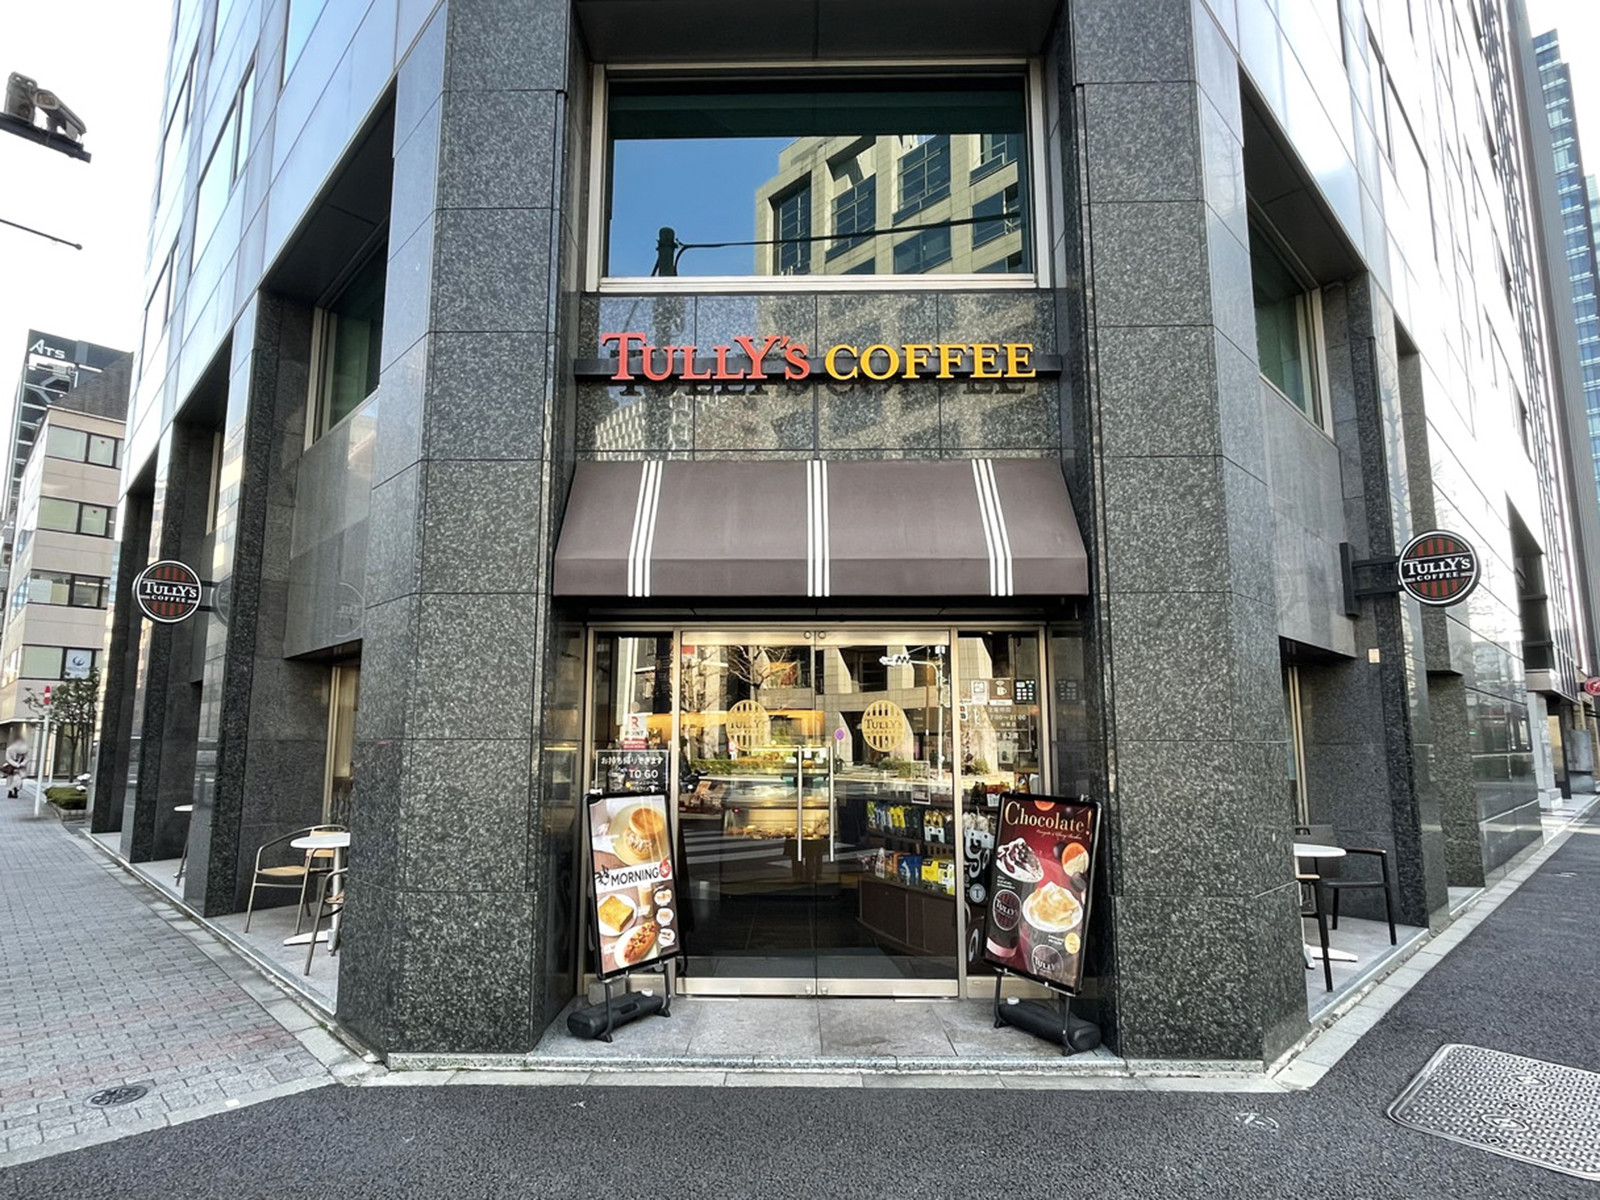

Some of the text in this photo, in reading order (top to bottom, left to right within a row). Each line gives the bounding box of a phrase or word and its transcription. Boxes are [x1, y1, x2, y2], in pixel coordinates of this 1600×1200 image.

[29, 339, 66, 360] ATS
[602, 332, 1036, 381] TULLY'S COFFEE
[1403, 556, 1472, 576] TULLY'S
[1416, 571, 1459, 582] COFFEE
[142, 580, 198, 598] TULLY'S
[151, 594, 186, 603] COFFEE
[629, 768, 659, 779] TO GO
[1004, 800, 1093, 836] Chocolate!
[610, 866, 659, 887] MORNING
